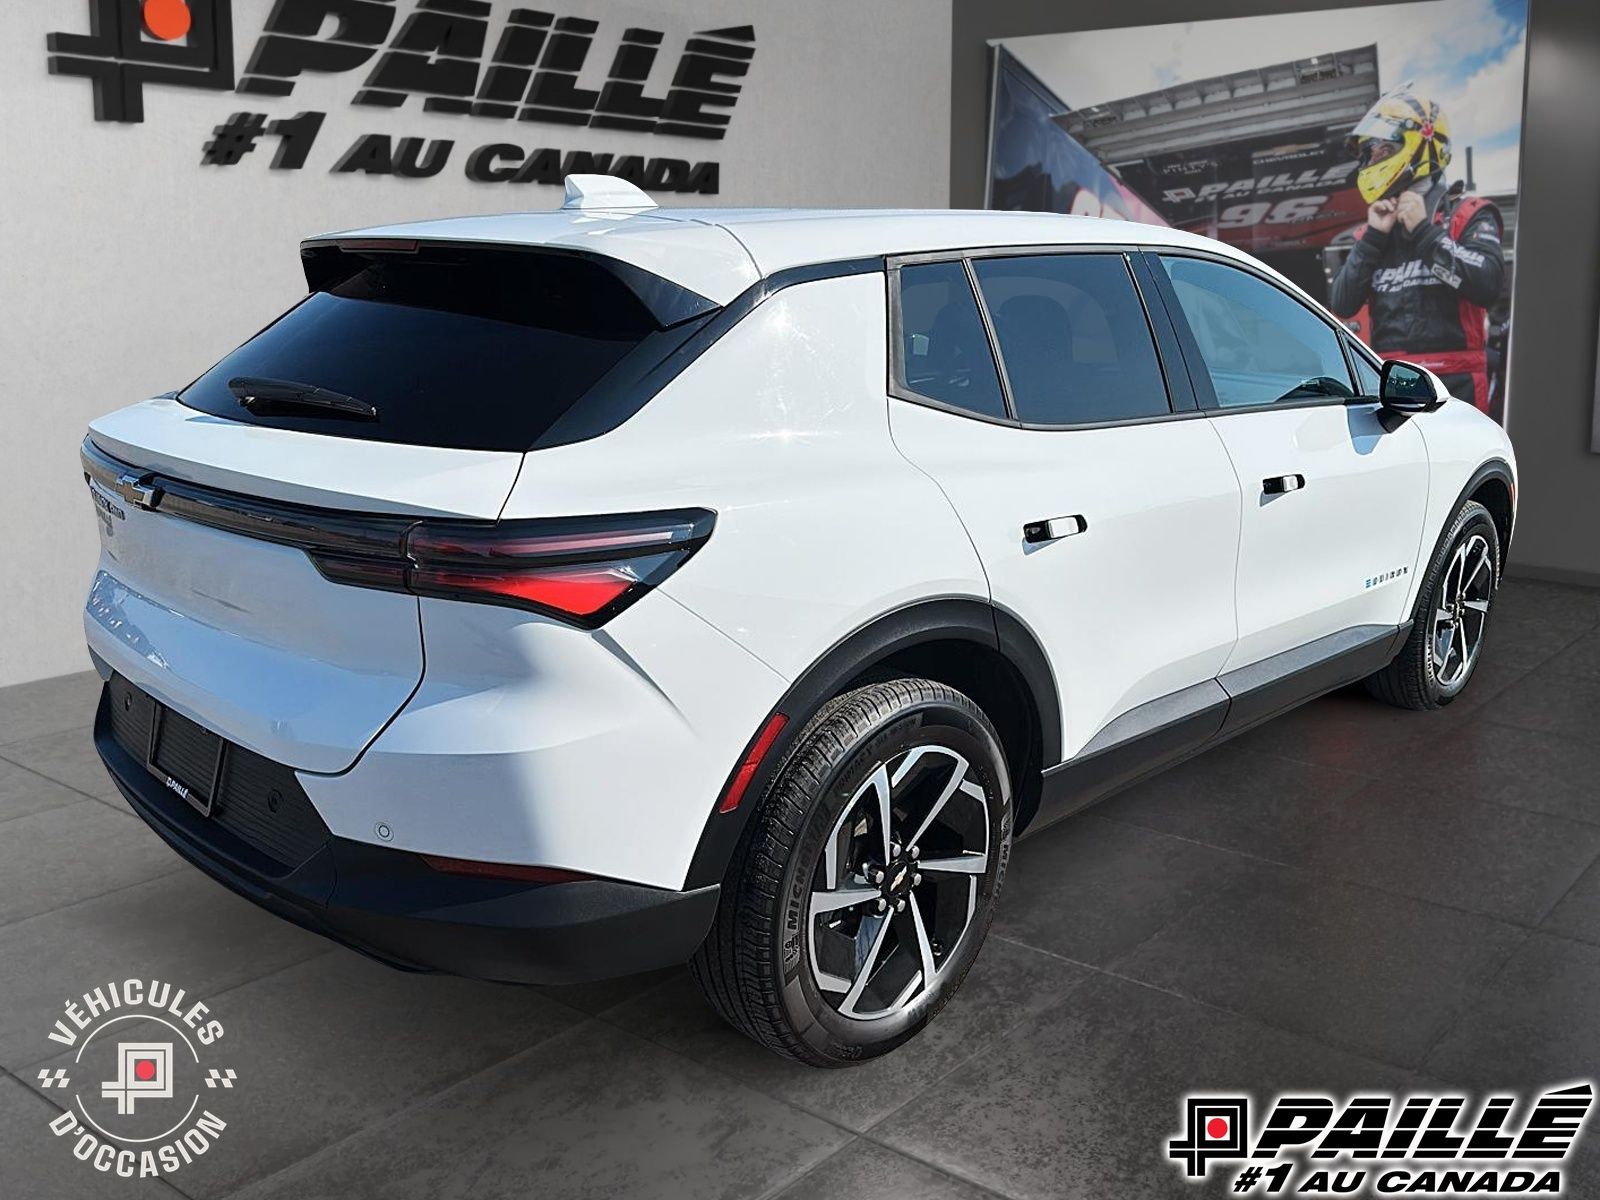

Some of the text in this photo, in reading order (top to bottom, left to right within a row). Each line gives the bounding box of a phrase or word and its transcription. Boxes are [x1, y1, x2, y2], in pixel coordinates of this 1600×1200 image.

[235, 0, 756, 140] PAILLÉ
[200, 111, 720, 195] #1 AU CANADA
[1217, 195, 1329, 229] 96
